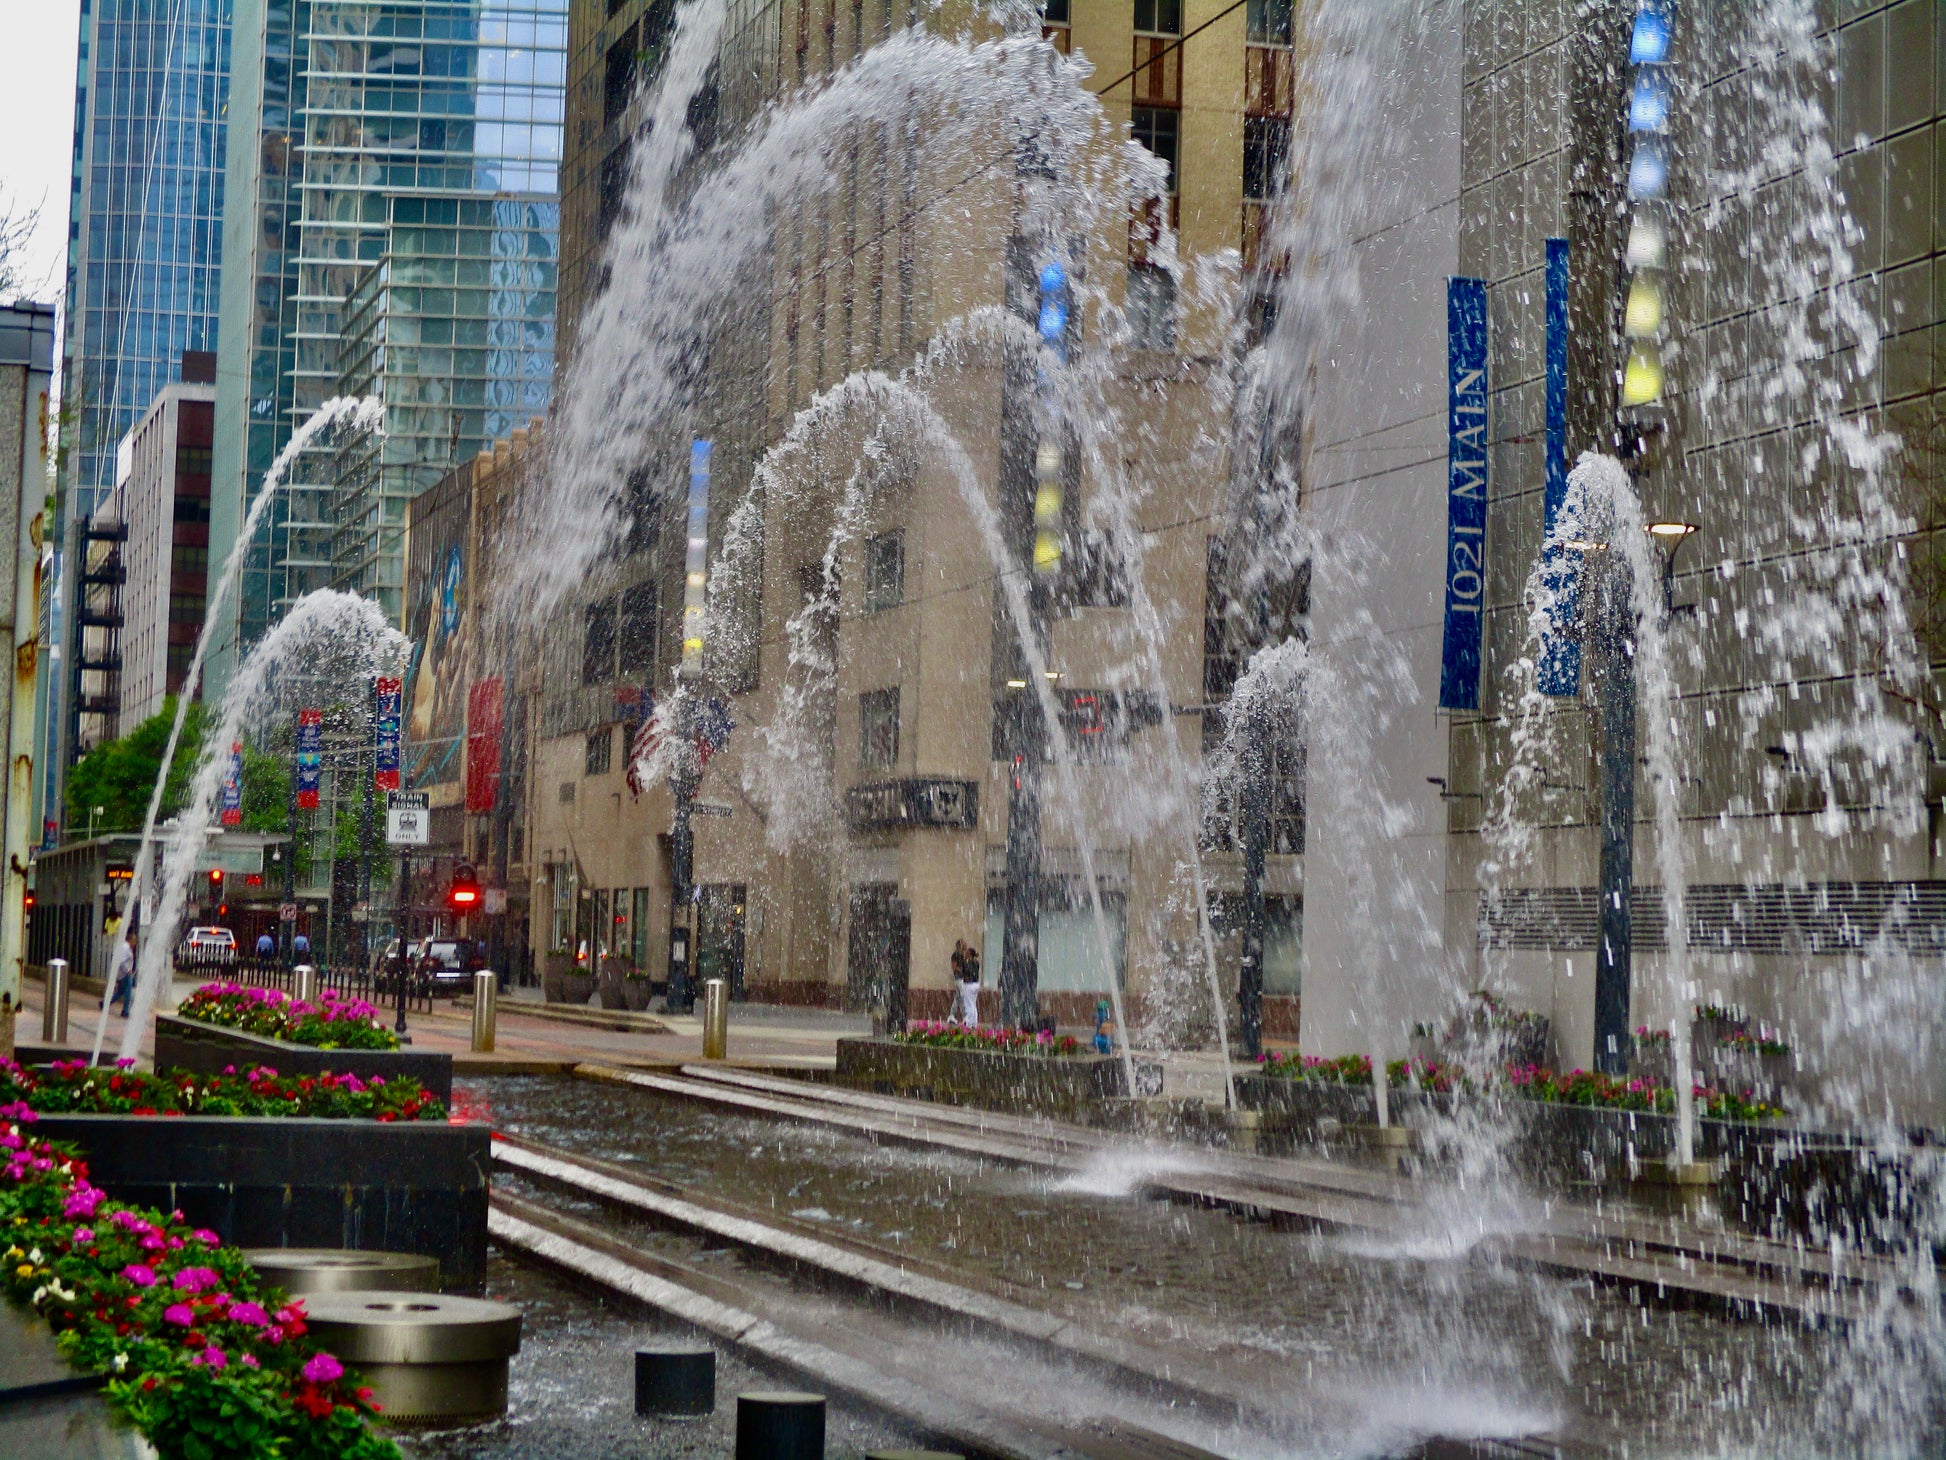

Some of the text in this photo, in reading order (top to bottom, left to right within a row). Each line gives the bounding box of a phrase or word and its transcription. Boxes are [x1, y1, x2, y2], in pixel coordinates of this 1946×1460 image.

[1451, 367, 1485, 614] 1021 MAIN
[395, 793, 423, 801] TRAIN
[391, 801, 426, 810] SIGNAL
